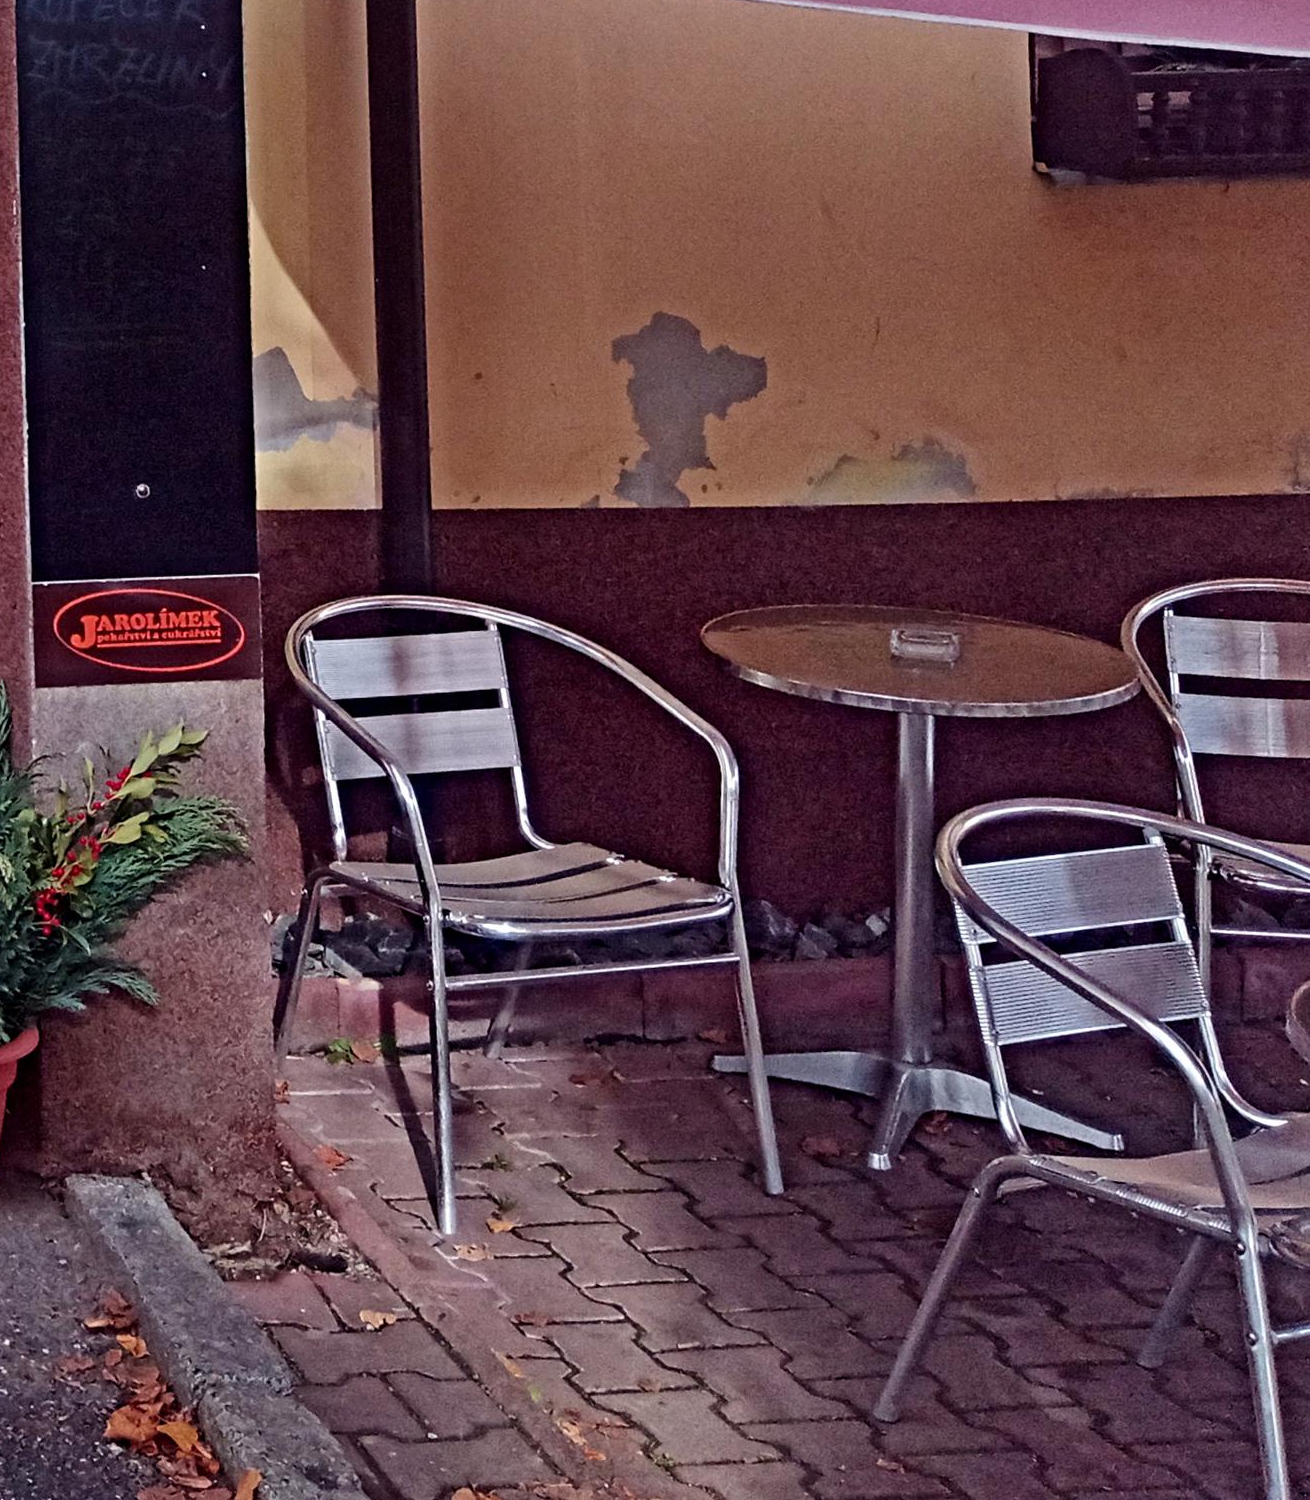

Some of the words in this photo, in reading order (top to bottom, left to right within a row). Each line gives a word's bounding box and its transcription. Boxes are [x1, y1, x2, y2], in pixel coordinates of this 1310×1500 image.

[71, 608, 221, 649] JAROLÍMEK
[97, 631, 150, 643] pekařství
[161, 628, 221, 639] cukrářství
